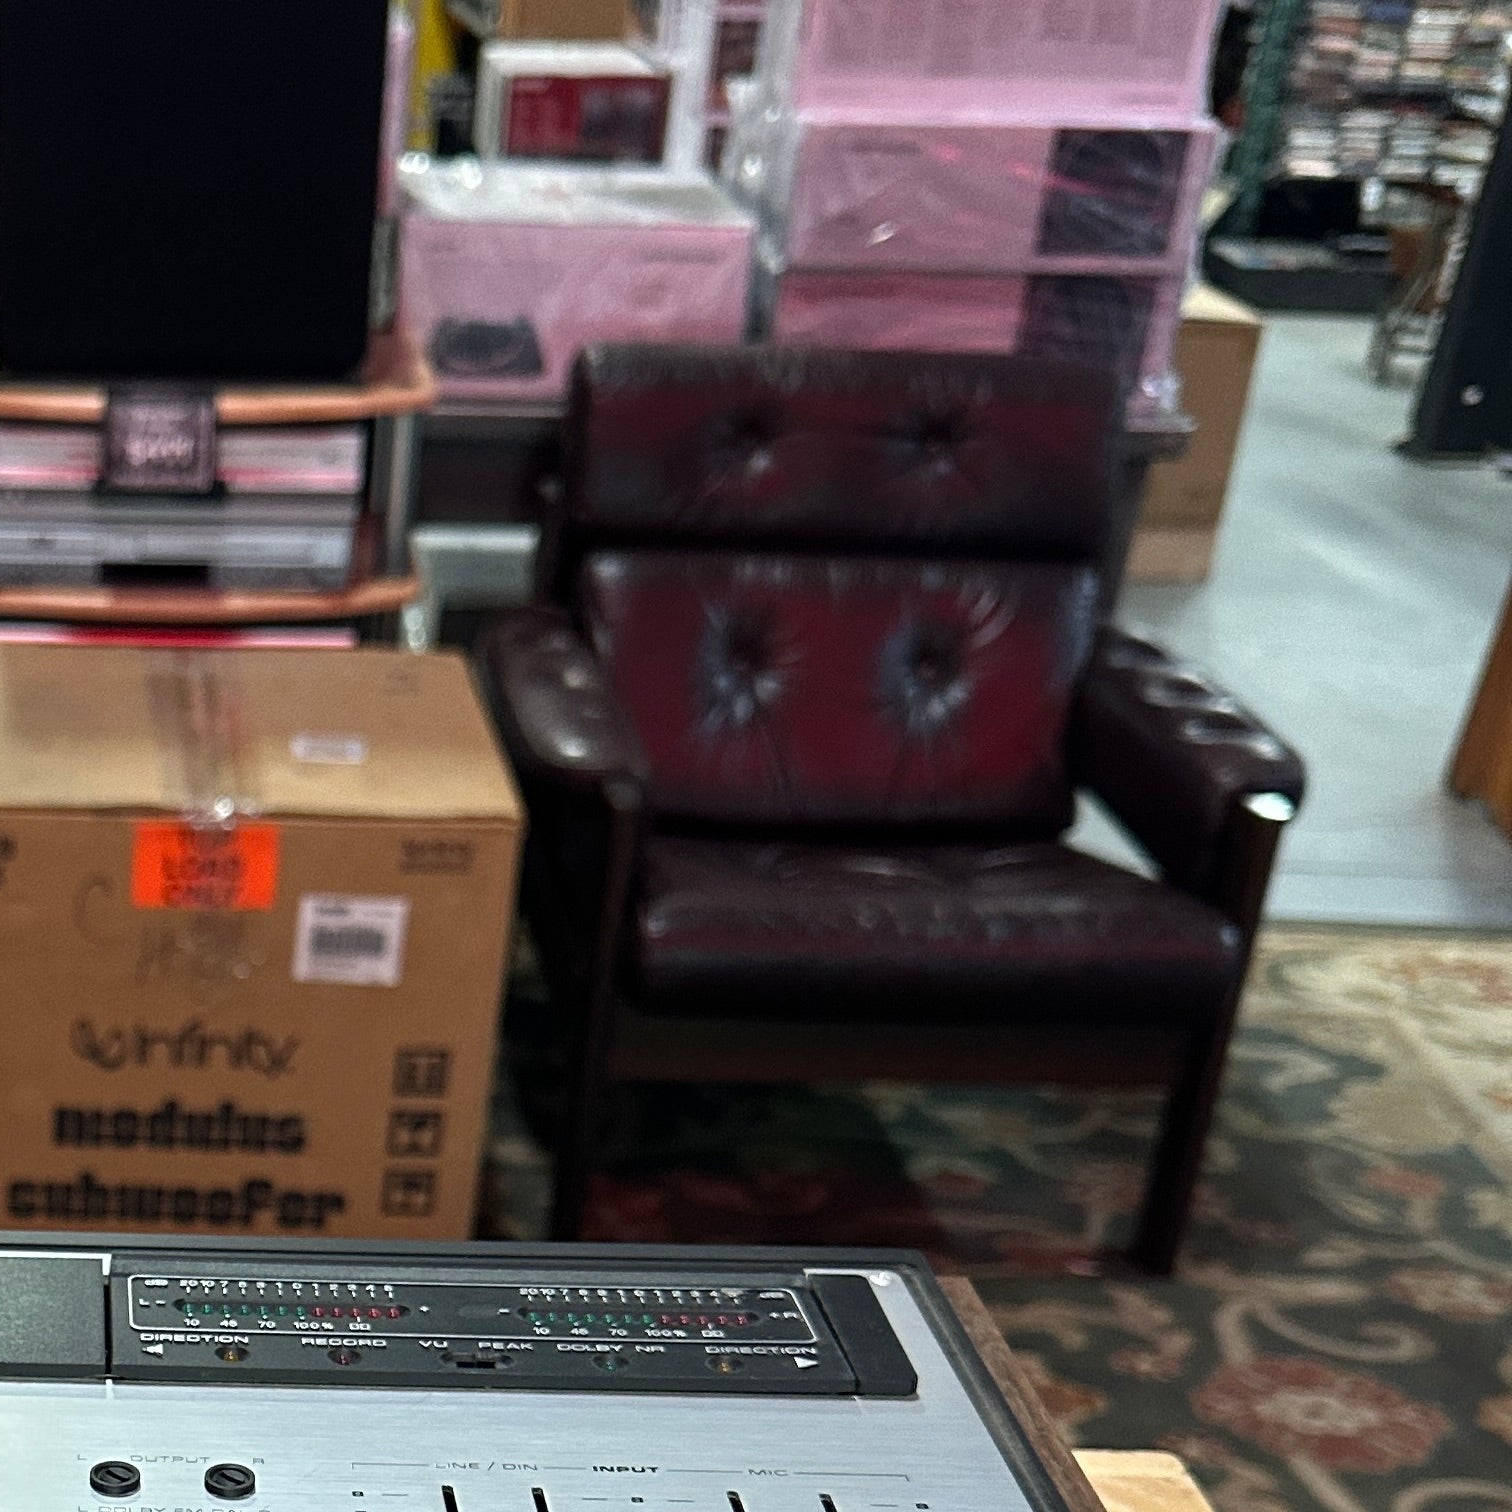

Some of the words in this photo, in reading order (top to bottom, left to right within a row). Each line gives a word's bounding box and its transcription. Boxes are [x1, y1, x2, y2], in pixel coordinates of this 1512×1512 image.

[52, 1100, 305, 1155] modulus
[183, 1318, 201, 1327] 10
[257, 1320, 277, 1329] 70
[533, 1326, 551, 1335] 10
[139, 1333, 249, 1344] DIRECTION
[301, 1337, 387, 1347] RECORD
[418, 1340, 449, 1348] VU
[478, 1341, 534, 1351] PEAK
[557, 1343, 623, 1353] DOLBY
[635, 1345, 665, 1353] NR
[704, 1345, 818, 1356] DIRECTION
[129, 1454, 212, 1463] OUTPUT
[434, 1463, 480, 1471] LINE
[592, 1464, 659, 1474] INPUT
[748, 1468, 788, 1477] MIC
